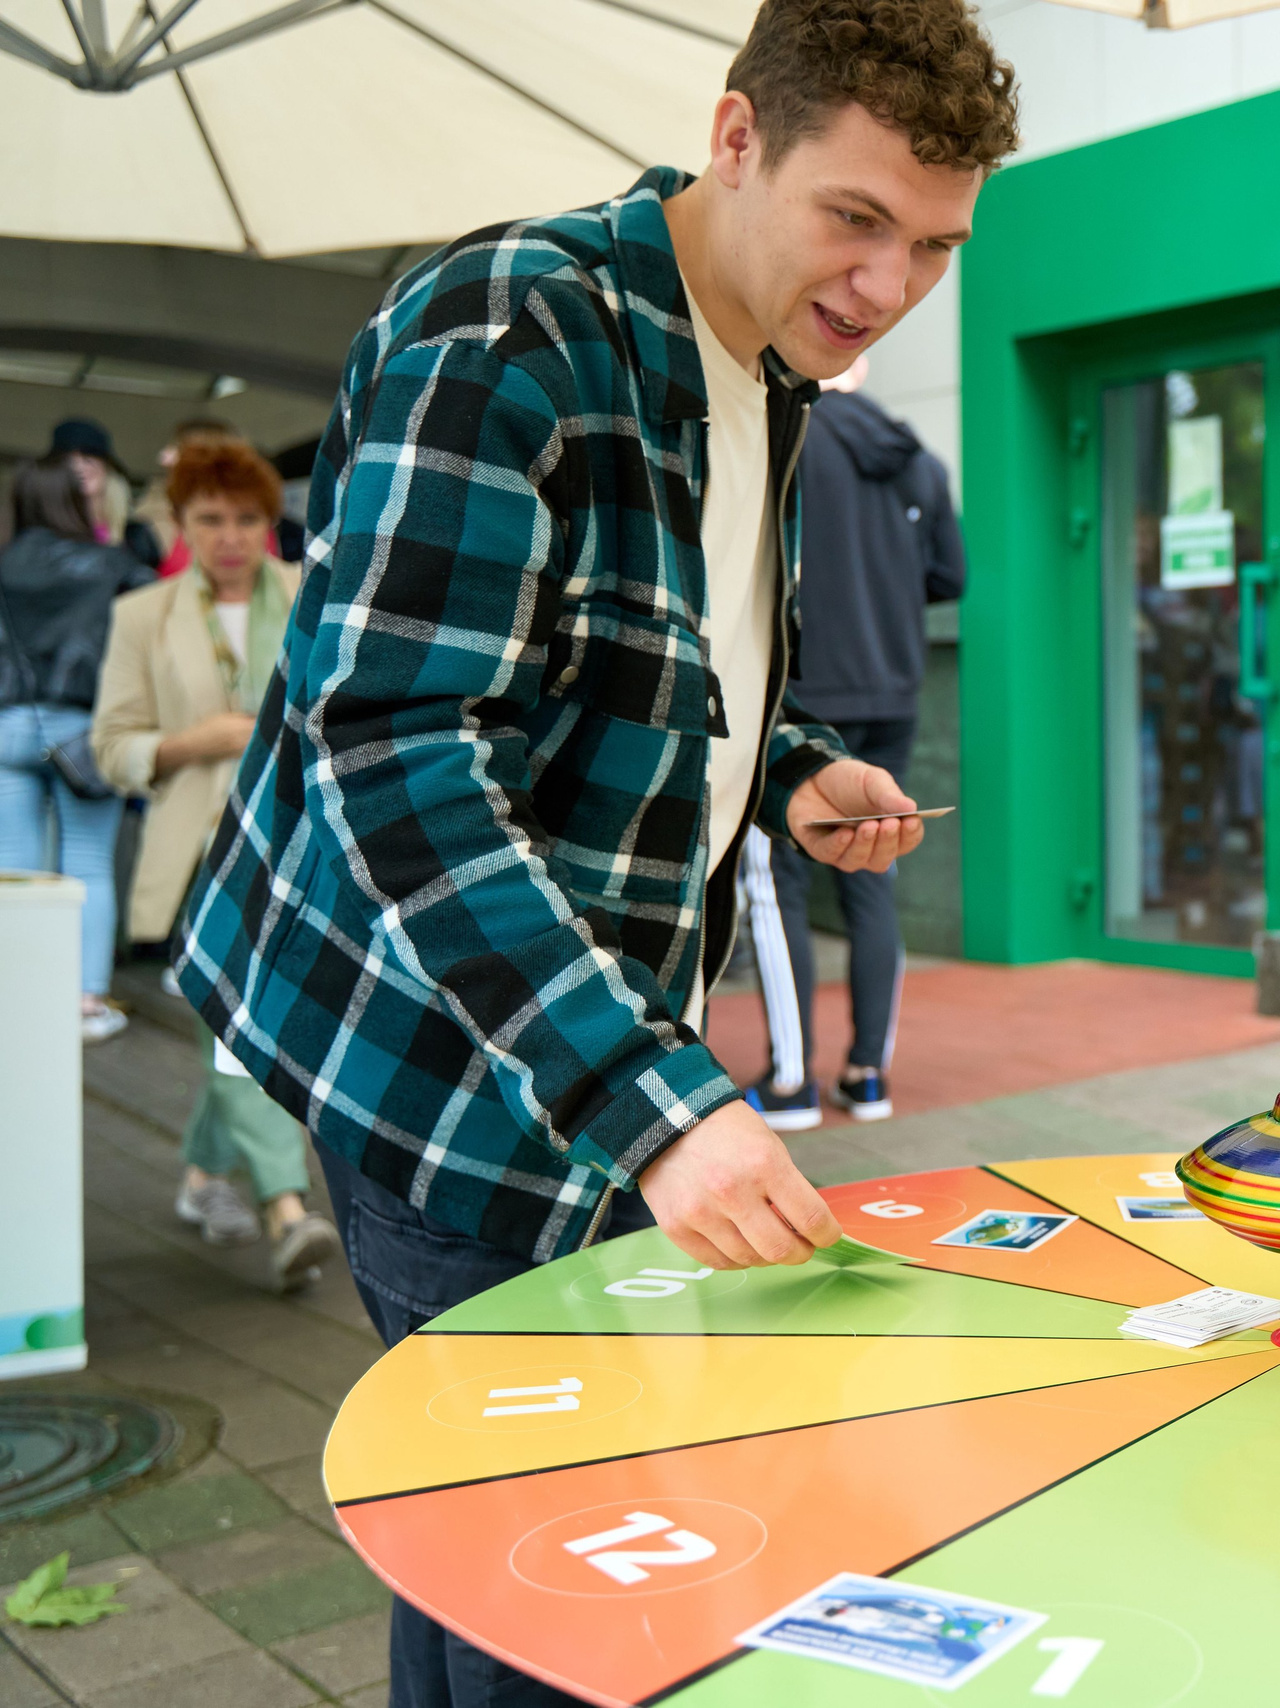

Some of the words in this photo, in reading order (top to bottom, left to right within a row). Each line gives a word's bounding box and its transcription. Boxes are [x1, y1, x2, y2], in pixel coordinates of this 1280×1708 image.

[1139, 1171, 1183, 1188] 8
[860, 1200, 924, 1218] 9
[603, 1268, 714, 1298] 10
[482, 1377, 583, 1417] 11
[563, 1511, 717, 1585] 12
[1032, 1636, 1104, 1698] 1
